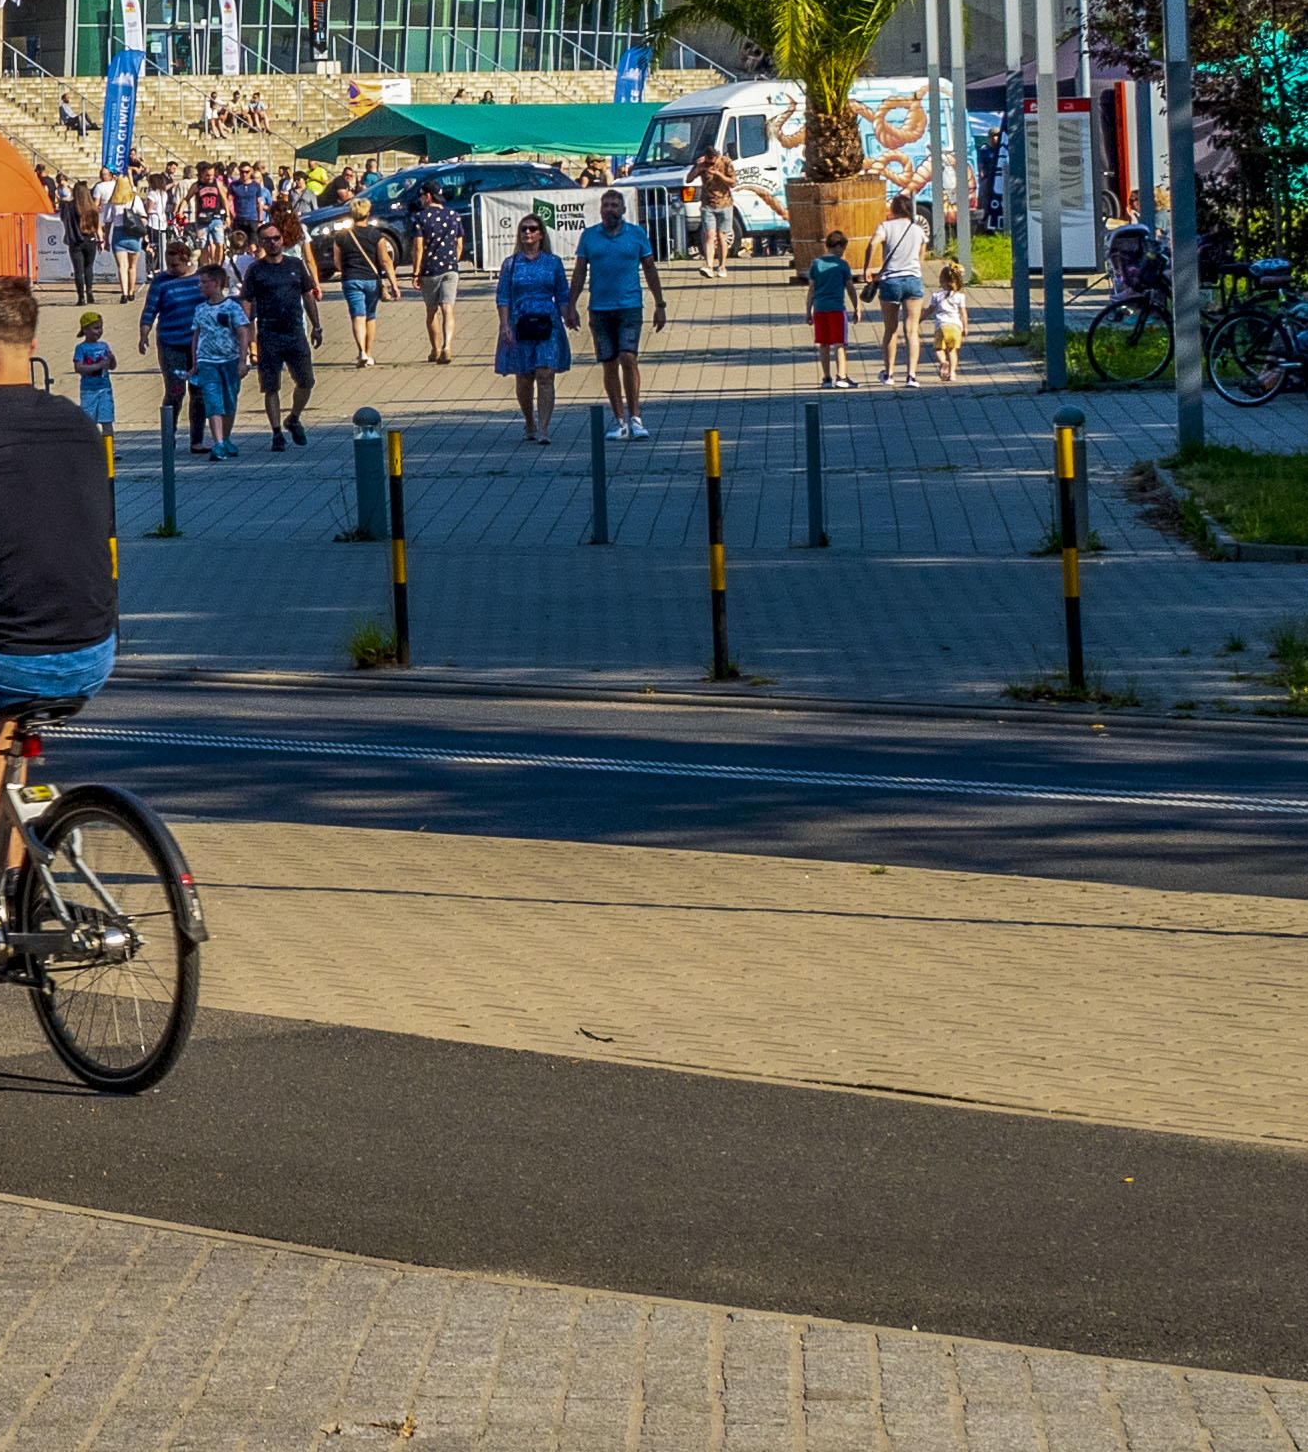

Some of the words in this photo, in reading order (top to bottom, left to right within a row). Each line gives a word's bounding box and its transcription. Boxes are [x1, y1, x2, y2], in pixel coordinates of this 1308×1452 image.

[118, 95, 131, 141] GLIWICE
[556, 203, 585, 212] LOTNY
[557, 220, 586, 231] PIWA
